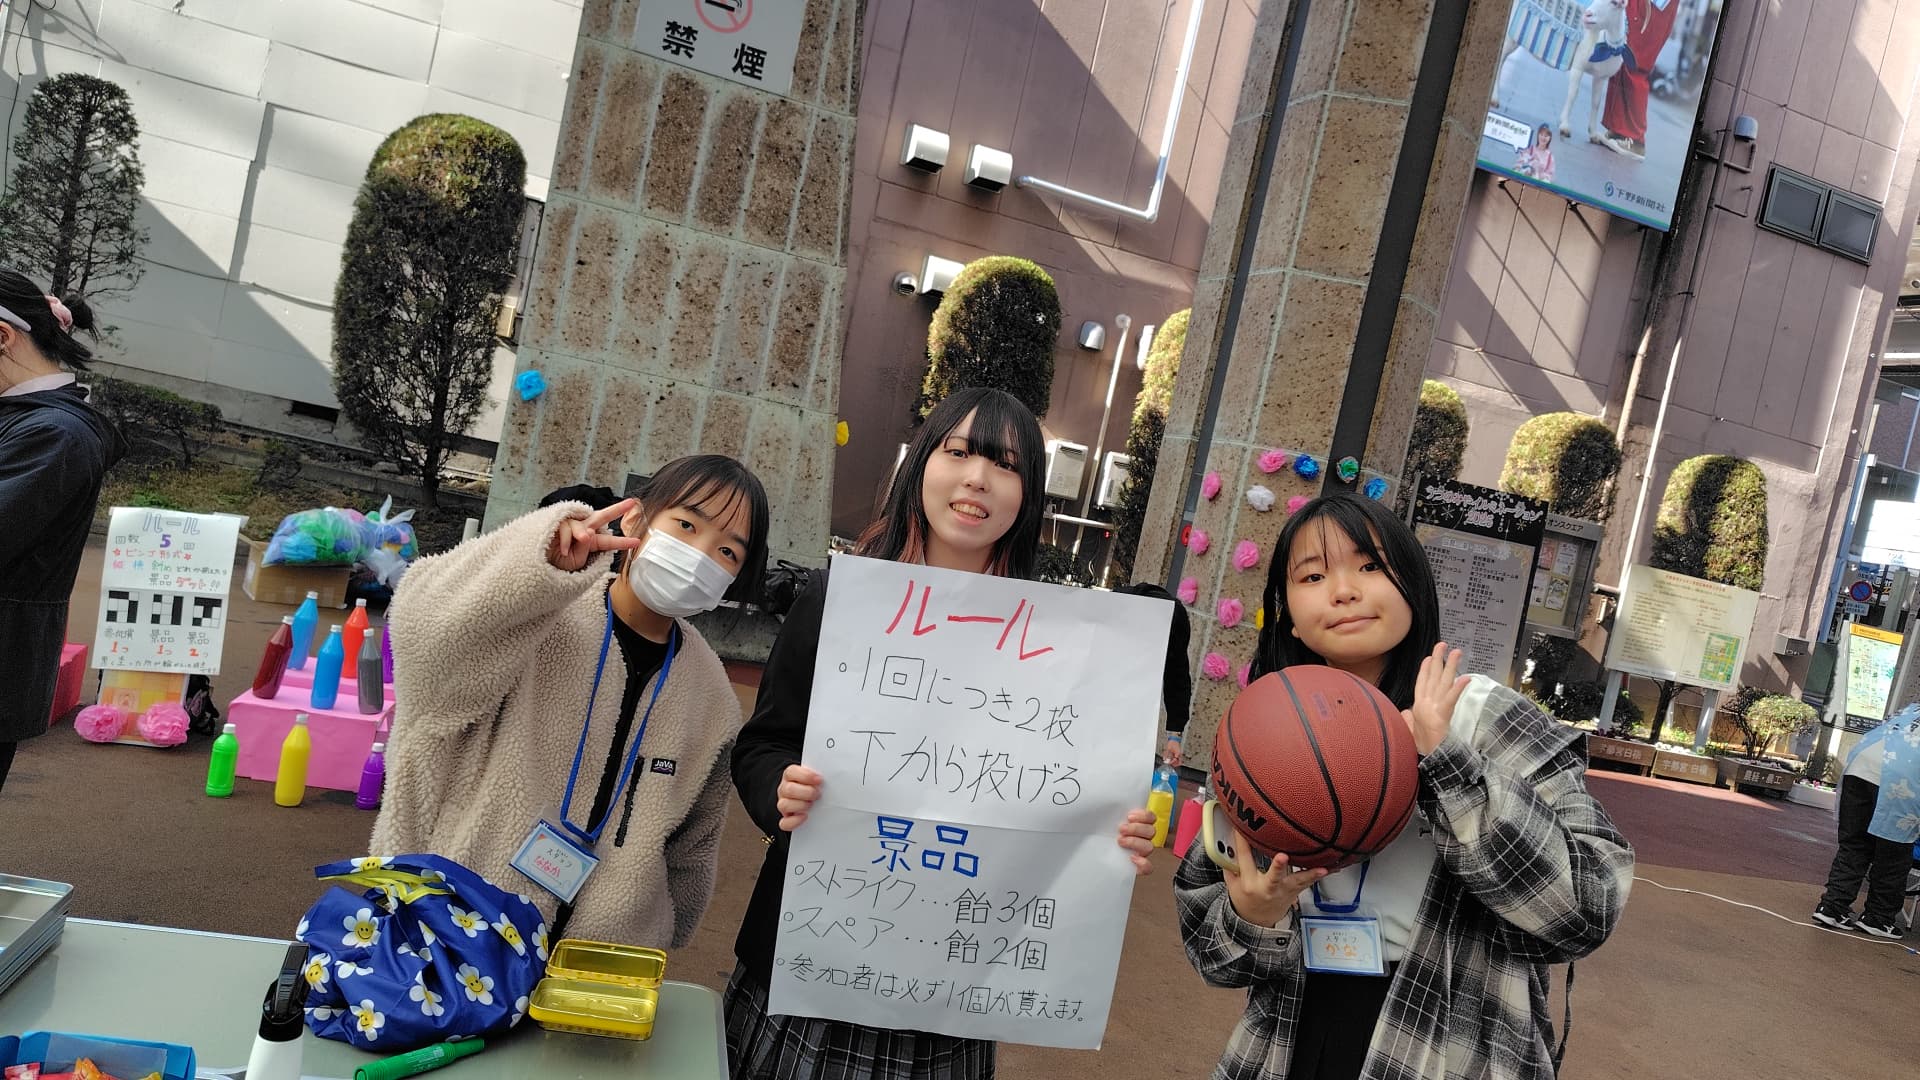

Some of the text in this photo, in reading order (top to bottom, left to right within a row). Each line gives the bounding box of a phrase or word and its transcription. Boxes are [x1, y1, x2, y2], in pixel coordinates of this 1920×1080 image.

[662, 20, 767, 80] 禁煙
[1616, 187, 1665, 212] 下野新聞社
[143, 512, 200, 535] ルール
[160, 533, 172, 549] 5
[885, 580, 1055, 661] ルール
[861, 647, 1080, 747] 1回につき2投
[655, 759, 673, 769] JaVa
[849, 729, 1081, 807] 下から投げる
[867, 815, 979, 878] 景品
